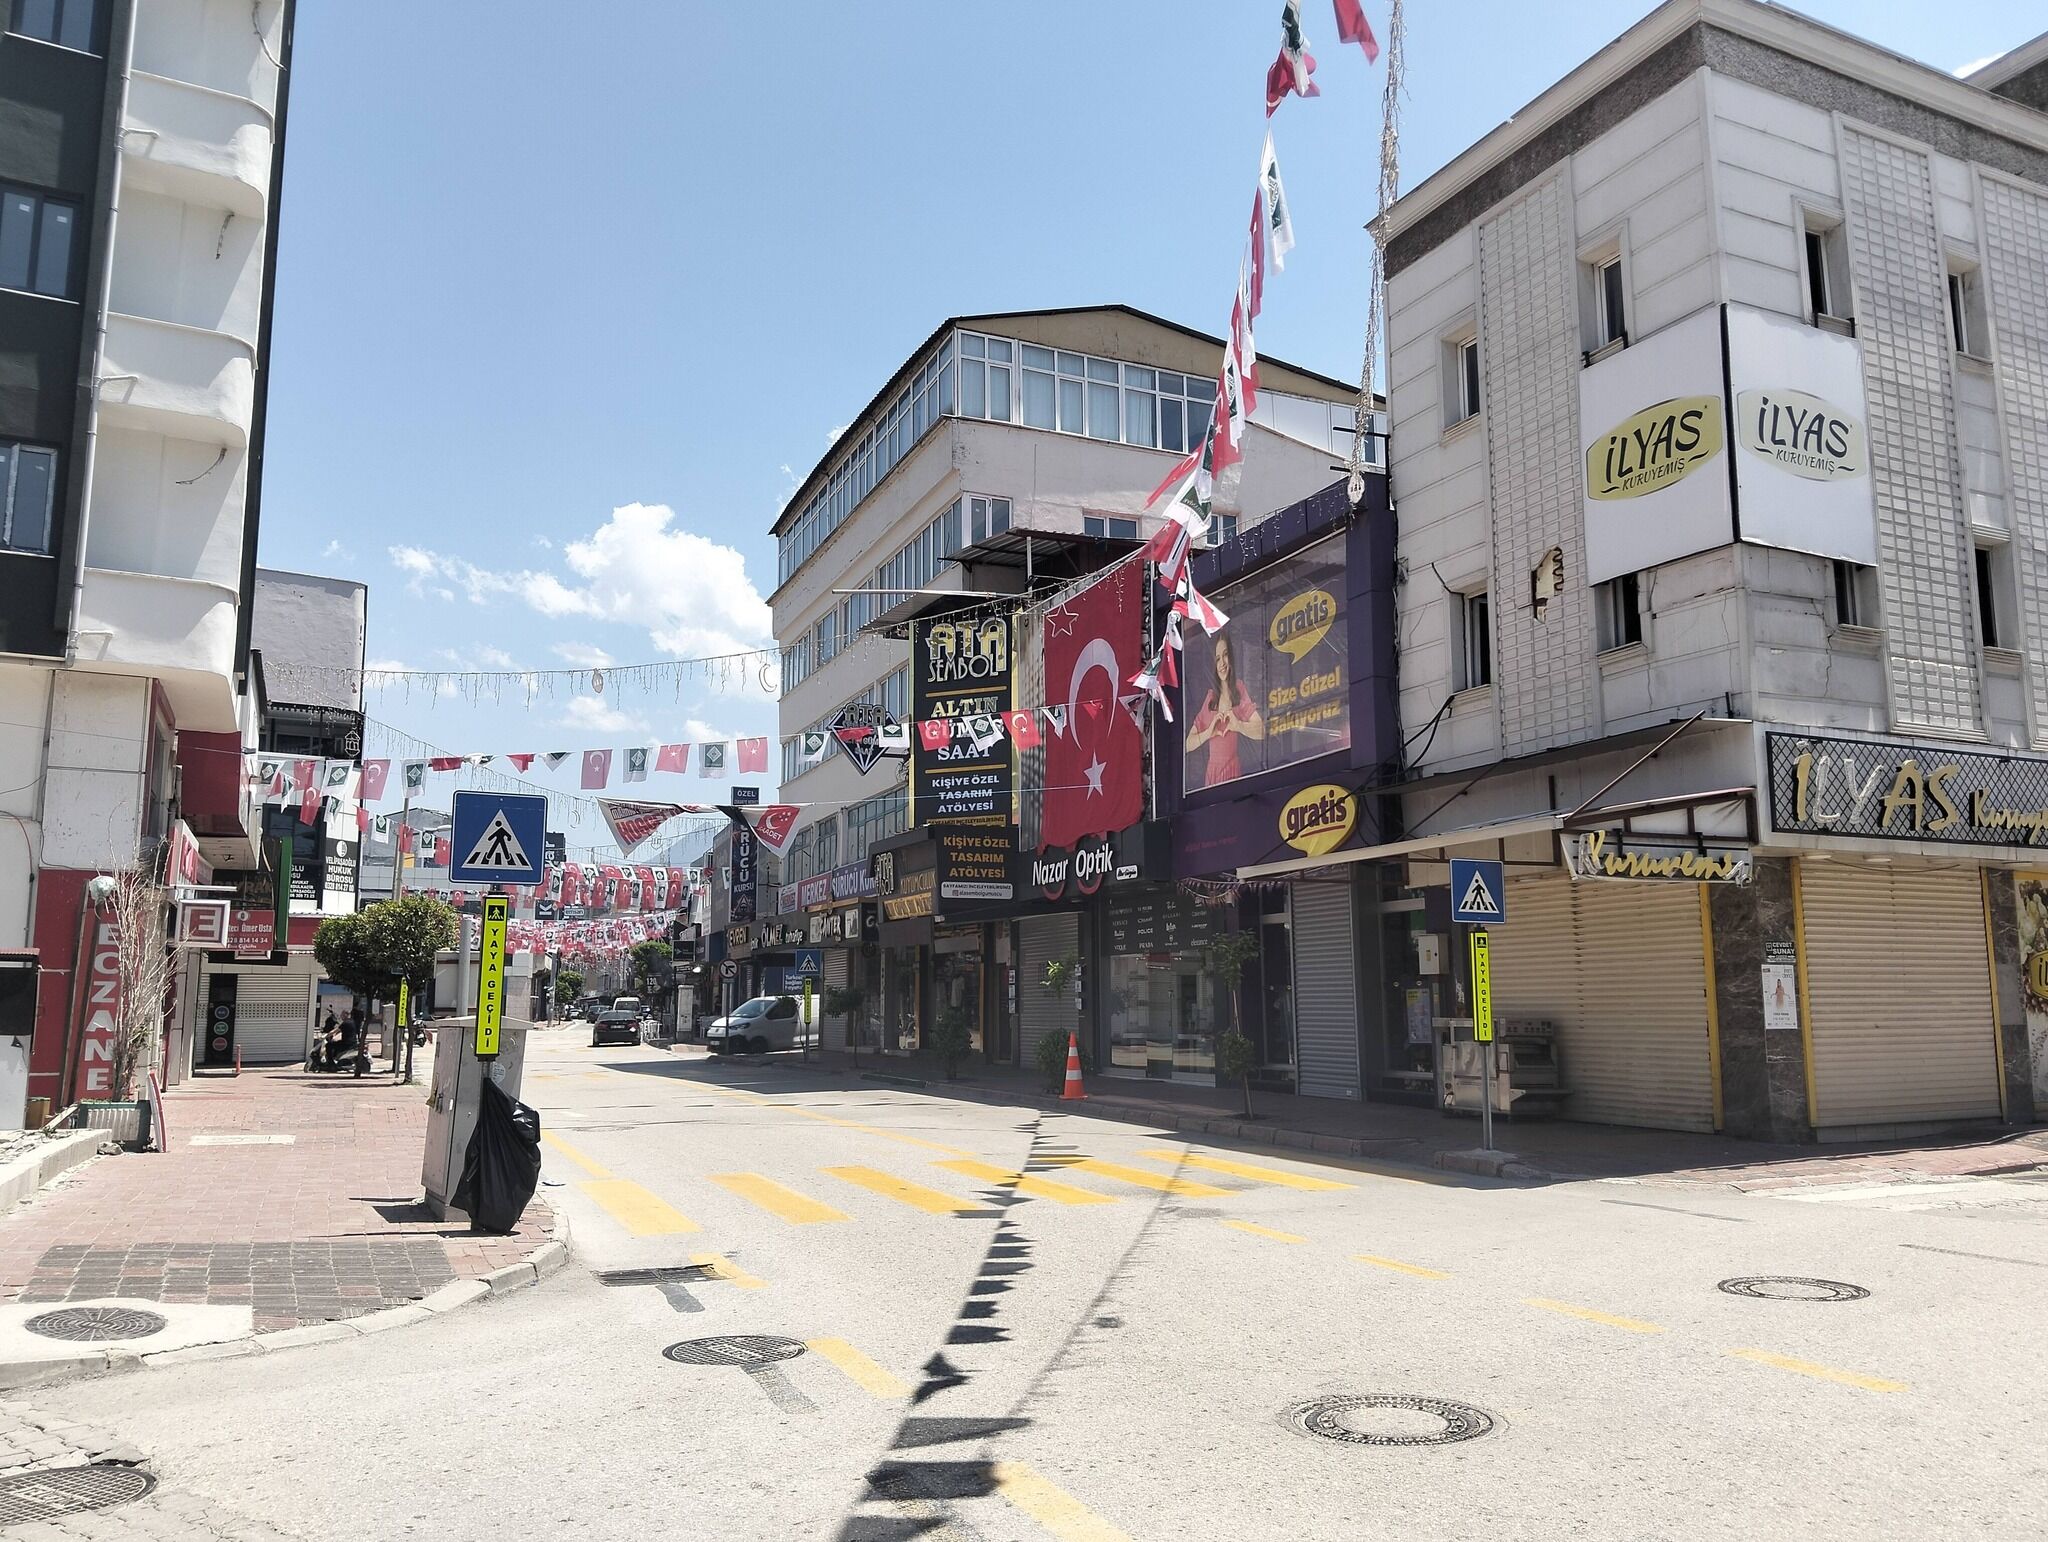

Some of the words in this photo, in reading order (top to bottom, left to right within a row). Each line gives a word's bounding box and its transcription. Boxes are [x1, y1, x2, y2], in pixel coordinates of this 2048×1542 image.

[1758, 396, 1849, 458] İLYAS
[1606, 410, 1704, 483] İLYAS
[1776, 449, 1835, 474] KURUYEMİŞ
[1622, 457, 1685, 491] KURUYEMİŞ
[1277, 594, 1329, 646] gratis
[924, 617, 1007, 671] ATA
[927, 653, 999, 683] SEMBOL
[1268, 686, 1298, 709] Size
[1299, 665, 1341, 698] Güzel
[930, 696, 999, 719] ALTIN
[932, 775, 970, 790] KİŞİYE
[971, 774, 1000, 785] ÖZEL
[939, 788, 993, 801] TASARIM
[1793, 740, 1961, 832] İLYAS
[937, 799, 994, 814] ATÖLYESİ
[1286, 789, 1347, 840] gratis
[943, 834, 982, 850] KİŞİYE
[982, 835, 1011, 848] ÖZEL
[950, 852, 1004, 863] TASARIM
[326, 872, 354, 885] BÜROSU
[328, 864, 353, 876] HUKUK
[949, 865, 1005, 879] ATÖLYESİ
[1032, 858, 1069, 887] Nazar
[1075, 842, 1114, 881] Optik
[801, 878, 827, 906] MERKEZ
[488, 928, 499, 973] YAYA
[761, 923, 783, 949] ÖLMEZ
[83, 922, 120, 1092] ECZANE
[485, 980, 497, 1048] GEÇİDİ
[1480, 989, 1488, 1037] GEÇİDİ
